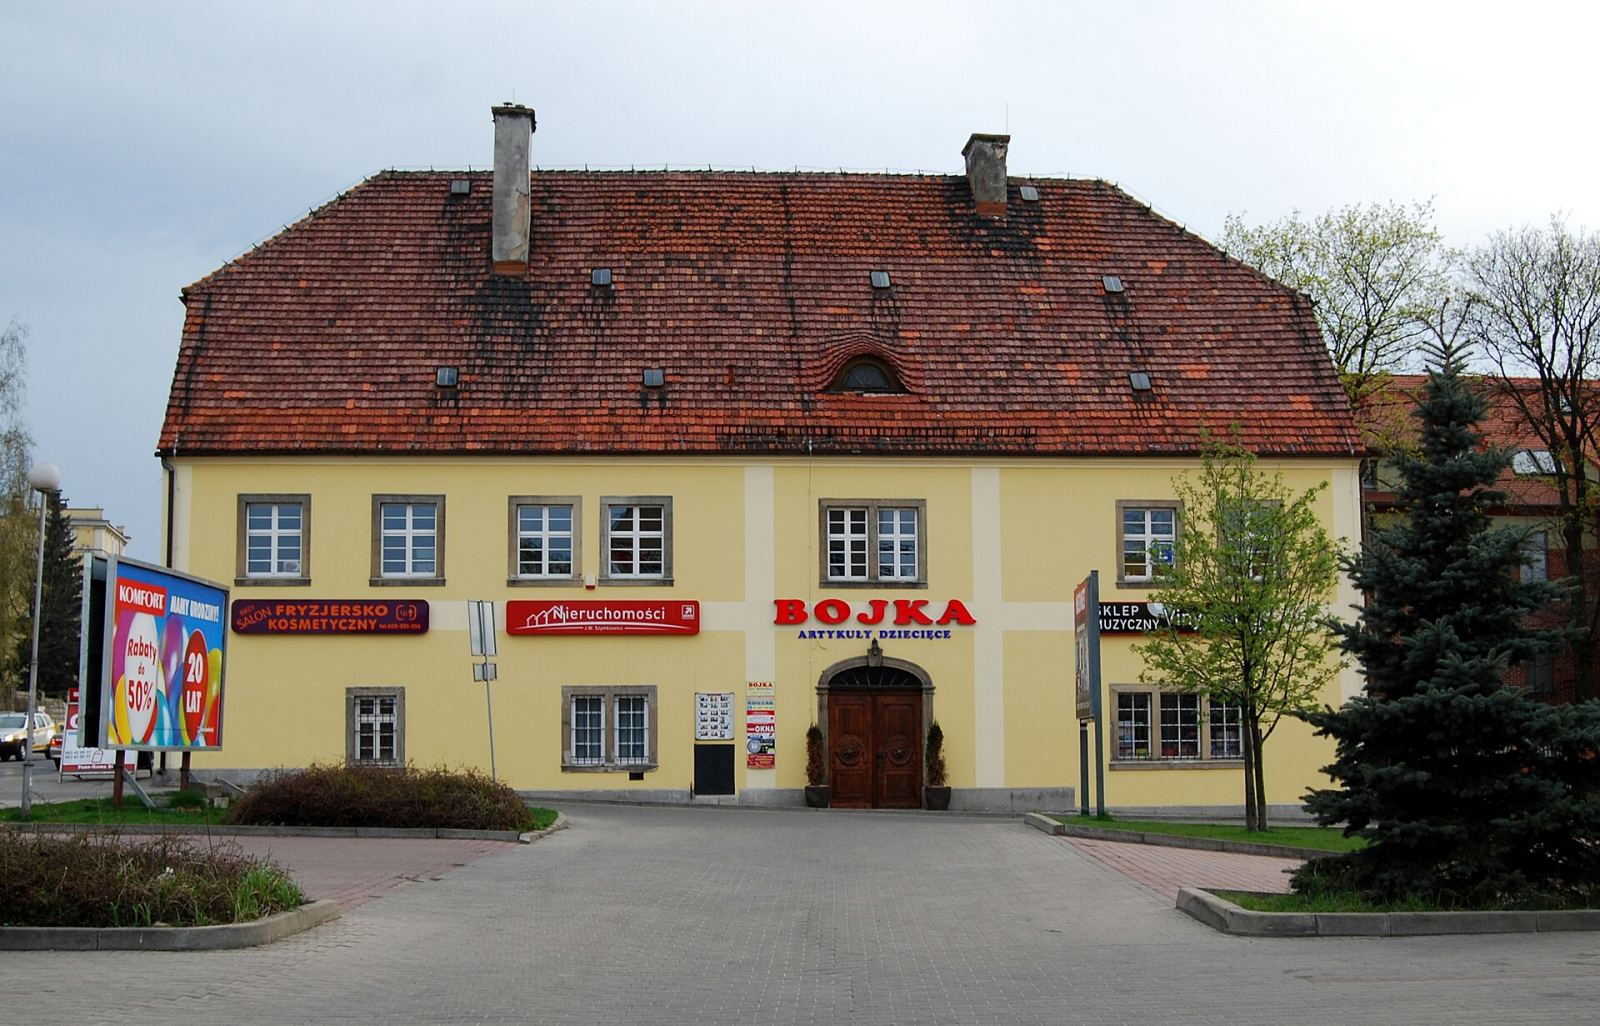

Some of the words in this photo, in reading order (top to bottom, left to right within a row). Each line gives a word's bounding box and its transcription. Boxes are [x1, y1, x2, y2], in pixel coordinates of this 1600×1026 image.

[119, 585, 164, 609] KOMFORT
[170, 595, 189, 615] MAMY
[190, 600, 219, 622] URODZINY!
[236, 606, 272, 630] SALON
[275, 604, 389, 617] FRYZJERSKO
[268, 618, 378, 631] KOSMETYCZNY
[553, 605, 665, 621] Nieruchomości
[774, 598, 977, 626] BOJKA
[798, 630, 873, 640] ARTYKUŁY
[879, 630, 951, 641] DZIECIĘCE
[127, 635, 157, 664] Rabaty
[138, 663, 145, 675] do
[188, 652, 202, 684] 20
[128, 680, 154, 712] 50%
[187, 691, 201, 713] LAT
